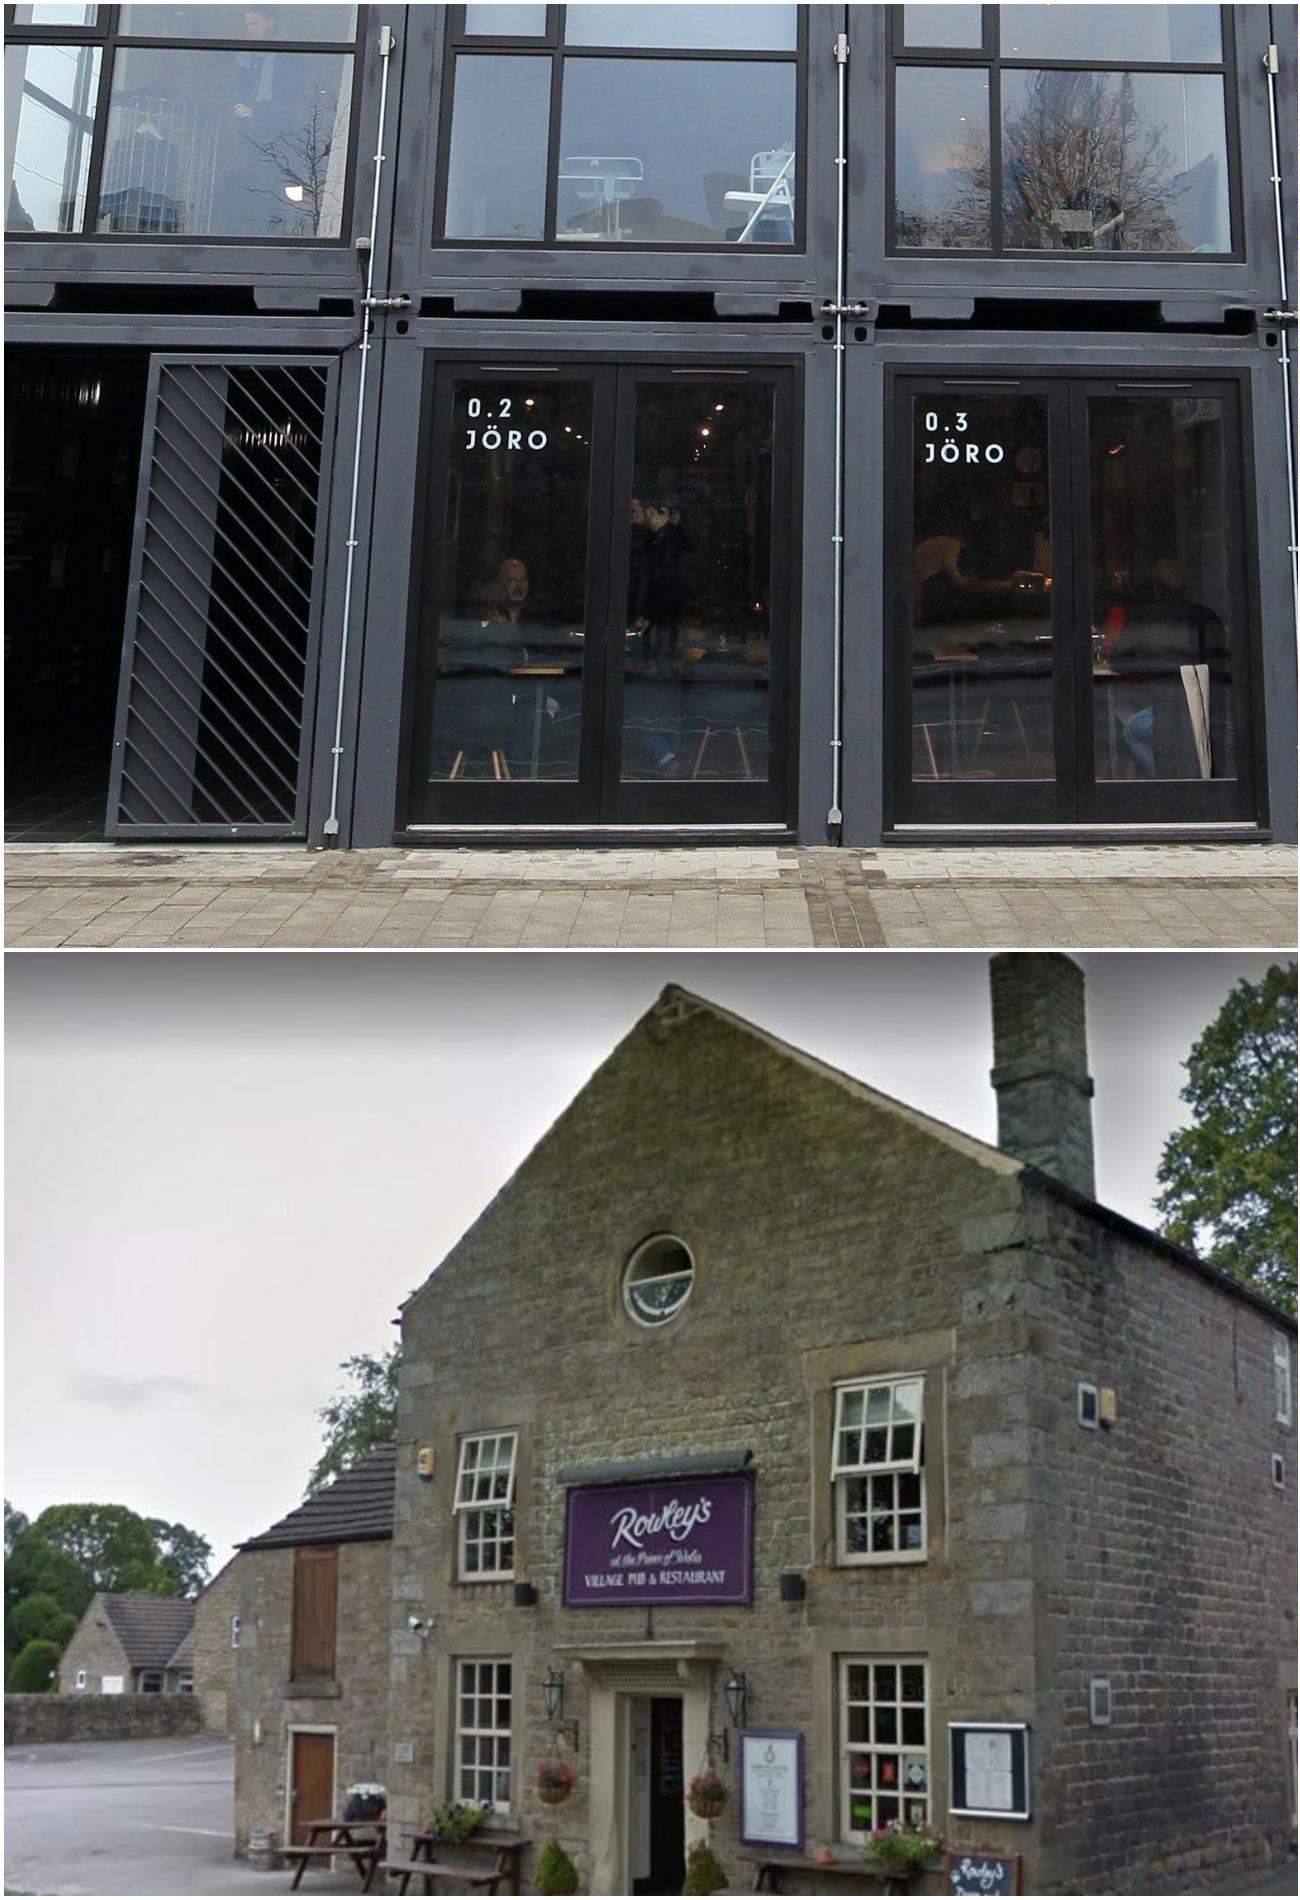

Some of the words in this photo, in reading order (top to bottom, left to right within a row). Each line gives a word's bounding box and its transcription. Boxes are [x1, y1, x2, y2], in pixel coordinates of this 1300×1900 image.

[468, 397, 512, 418] 0.2
[925, 411, 968, 432] 0.3
[465, 424, 548, 450] JÖRO
[924, 438, 1004, 464] JÖRO
[610, 1497, 712, 1548] Rowley's
[584, 1573, 624, 1588] VILLAGE
[628, 1572, 646, 1586] PUB
[648, 1573, 657, 1586] &
[660, 1570, 726, 1586] RESTAURANT
